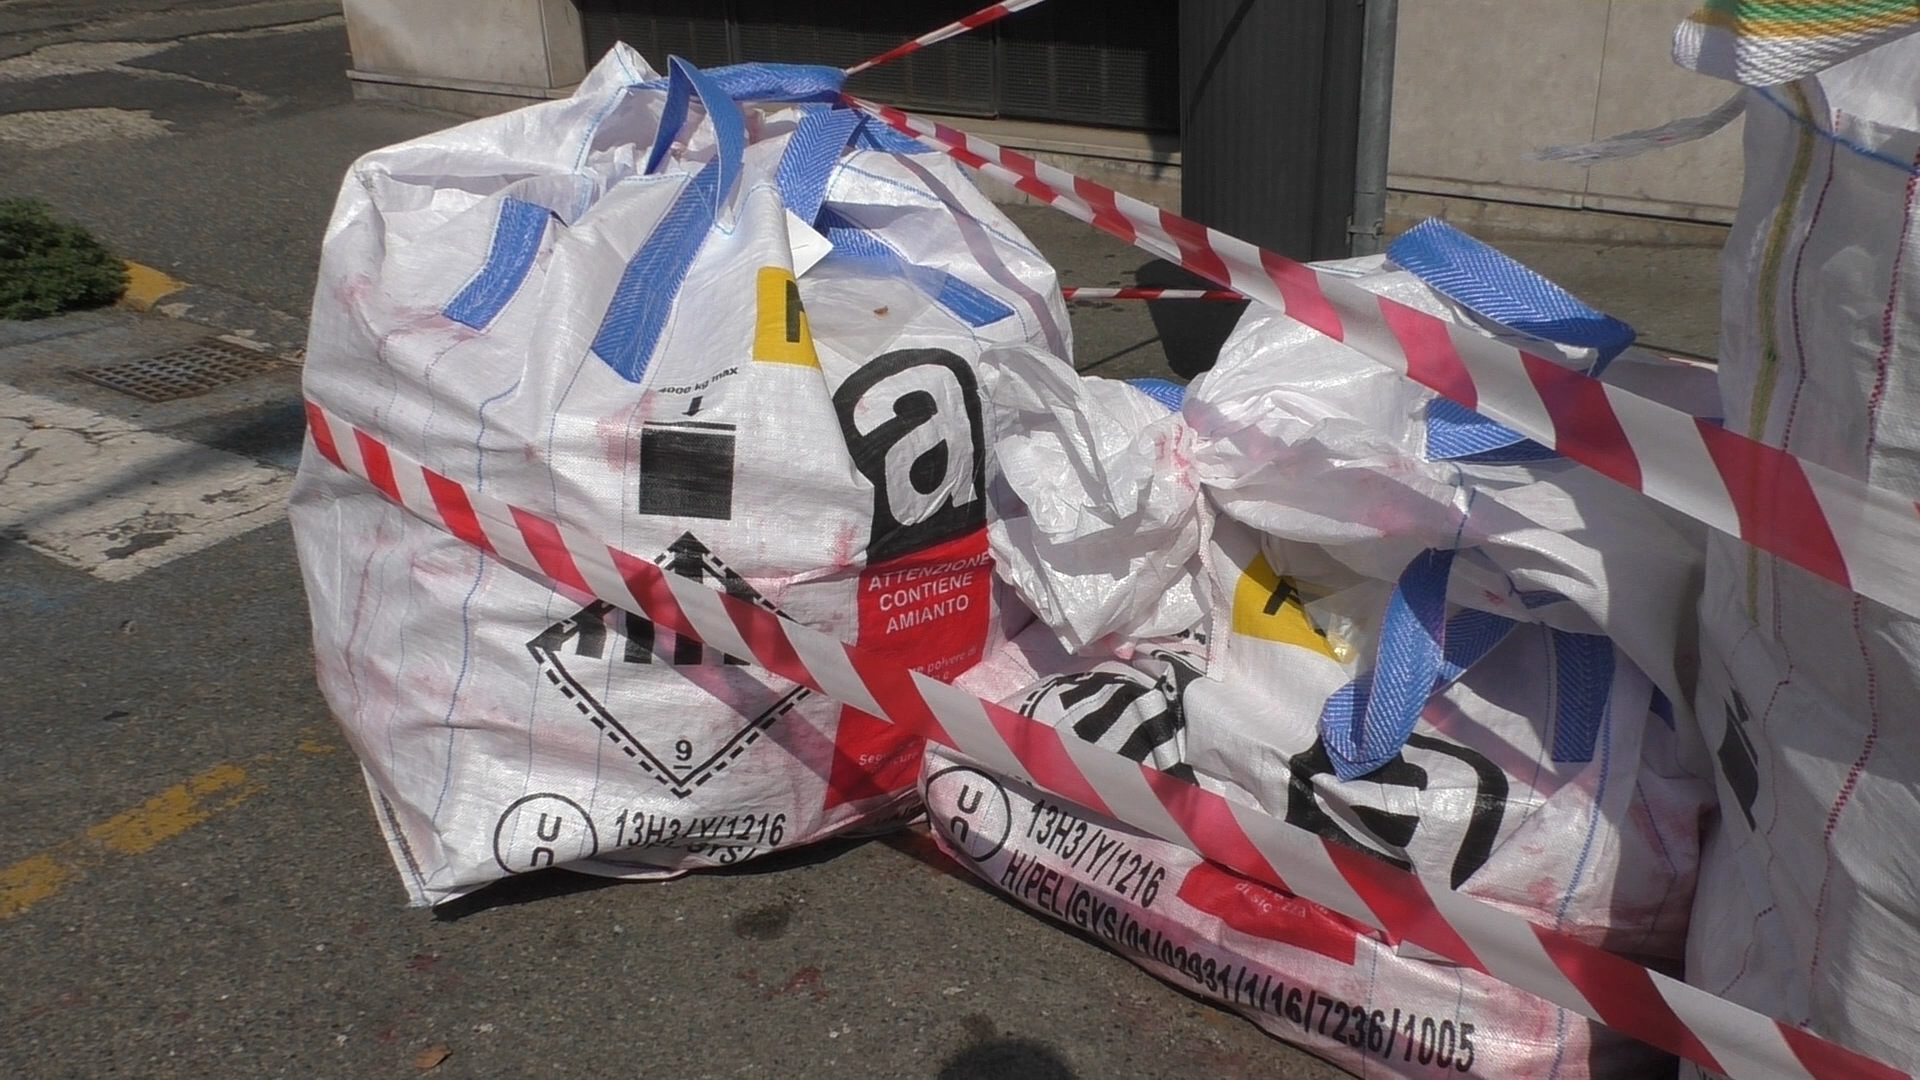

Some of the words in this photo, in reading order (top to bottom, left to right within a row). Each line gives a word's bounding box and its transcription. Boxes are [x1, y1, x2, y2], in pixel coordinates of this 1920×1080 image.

[694, 379, 710, 391] kg
[711, 366, 739, 382] max
[868, 550, 990, 592] ATTENZIONE
[879, 571, 974, 611] CONTIENE
[885, 594, 969, 635] AMIANTO
[674, 739, 693, 762] 9
[615, 808, 786, 847] 13H3/Y/1216
[1026, 798, 1166, 909] 13H3/Y/1216
